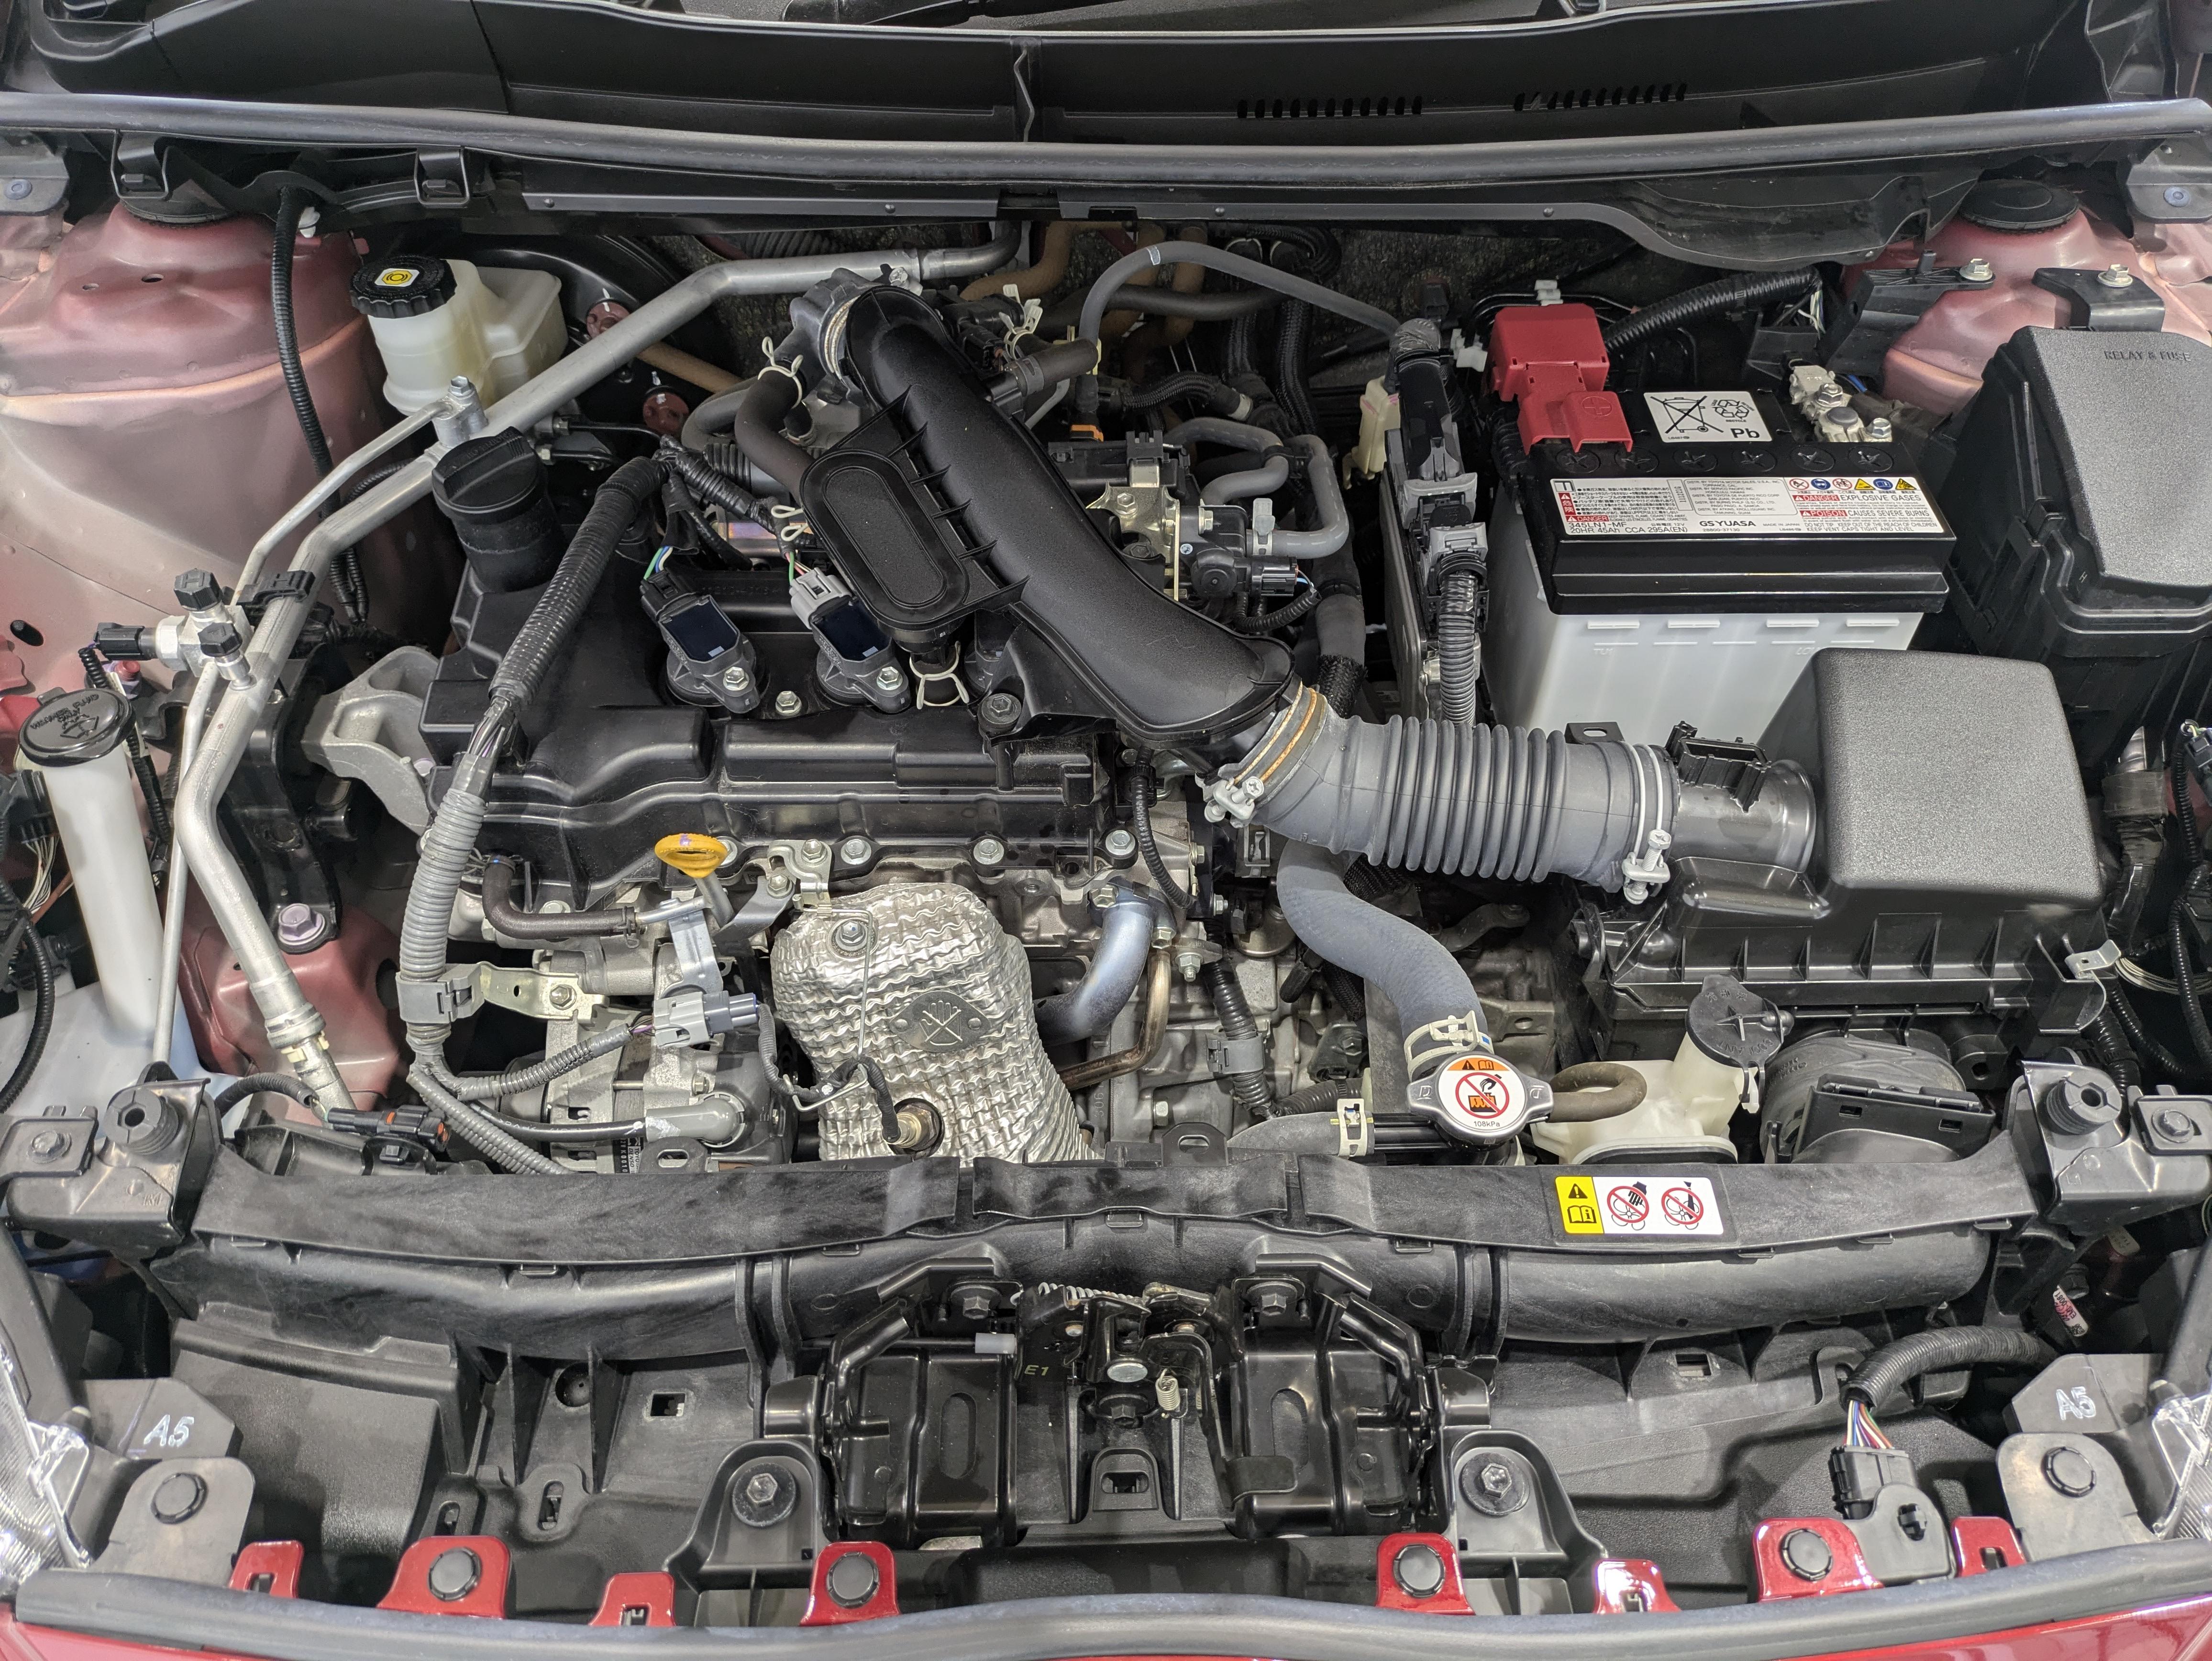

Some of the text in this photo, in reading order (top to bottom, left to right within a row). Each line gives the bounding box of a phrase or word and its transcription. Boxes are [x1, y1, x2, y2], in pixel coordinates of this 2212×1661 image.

[2104, 350, 2191, 362] RELAY & FUSE
[1730, 428, 1760, 438] Pb
[1025, 1364, 1049, 1376] E1
[2056, 1385, 2097, 1421] A5
[144, 1414, 195, 1448] A5
